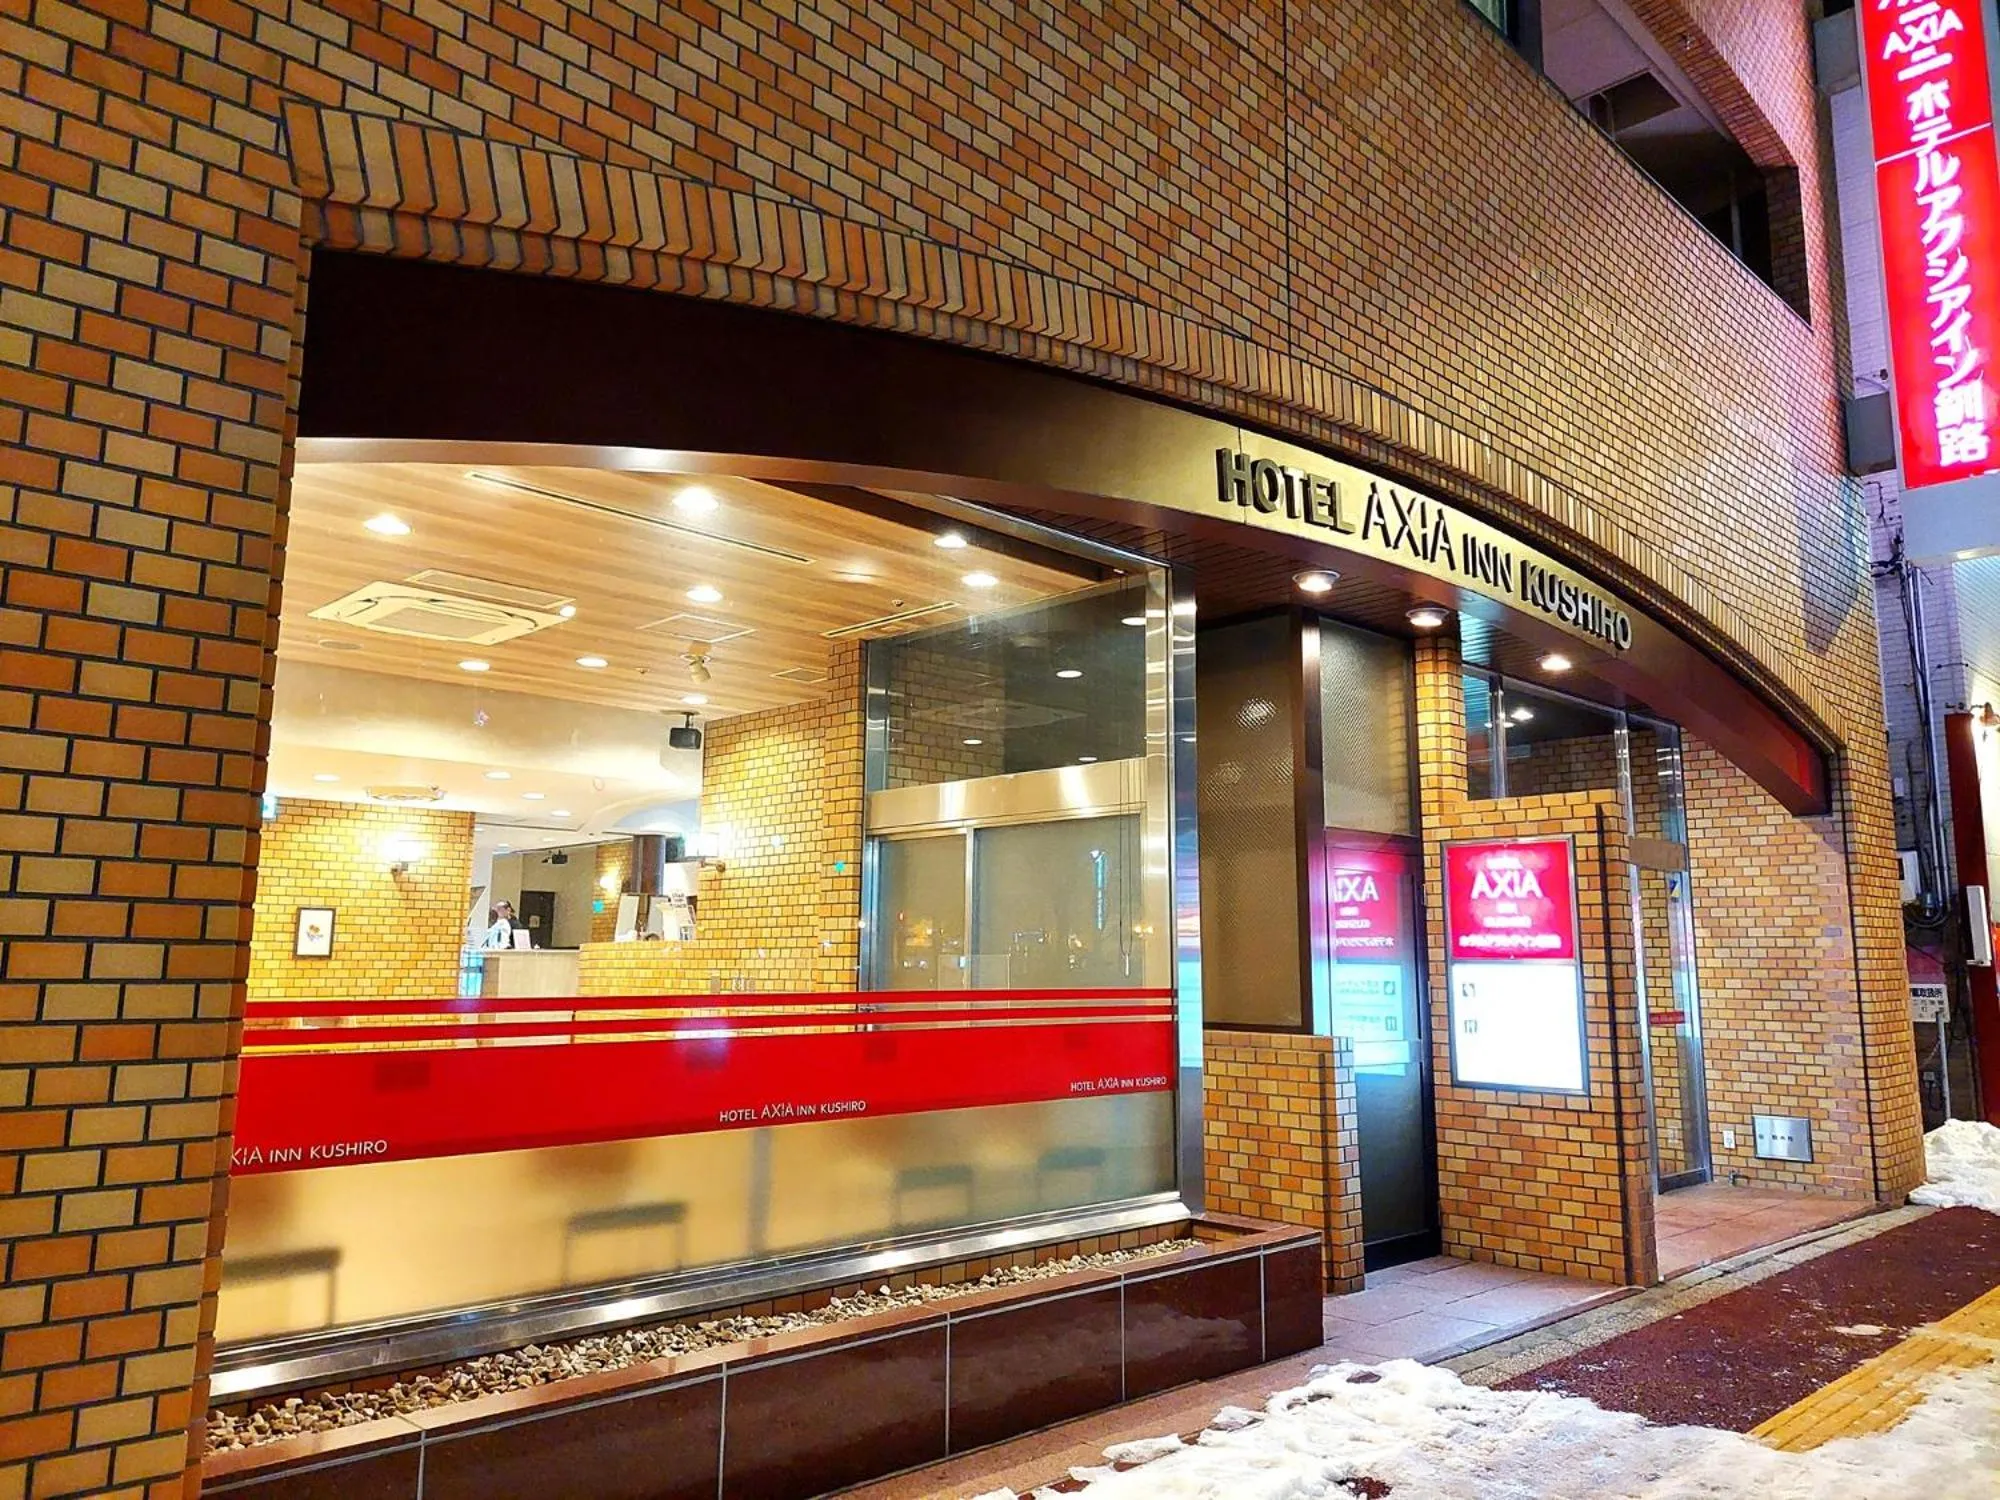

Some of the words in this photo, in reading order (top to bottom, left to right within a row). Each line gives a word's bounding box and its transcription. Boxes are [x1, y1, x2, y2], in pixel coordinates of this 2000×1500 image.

[1883, 8, 1963, 60] AXIA
[1906, 79, 1991, 467] ホテルアクシアイン釧路
[1216, 448, 1355, 535] HOTEL
[1362, 482, 1456, 571] AXIA
[1463, 532, 1513, 592] INN
[1520, 559, 1632, 651] KUSHIRO
[1471, 869, 1544, 900] AXIA
[1070, 1081, 1096, 1092] HOTEL
[1097, 1077, 1120, 1089] AXIA
[1120, 1078, 1134, 1088] INN
[1135, 1076, 1167, 1087] KUSHIRO
[719, 1109, 758, 1122] HOTEL
[760, 1103, 795, 1119] AXIA
[796, 1103, 817, 1116] INN
[820, 1100, 867, 1114] KUSHIRO
[269, 1147, 302, 1164] INN
[309, 1139, 388, 1160] KUSHIRO
